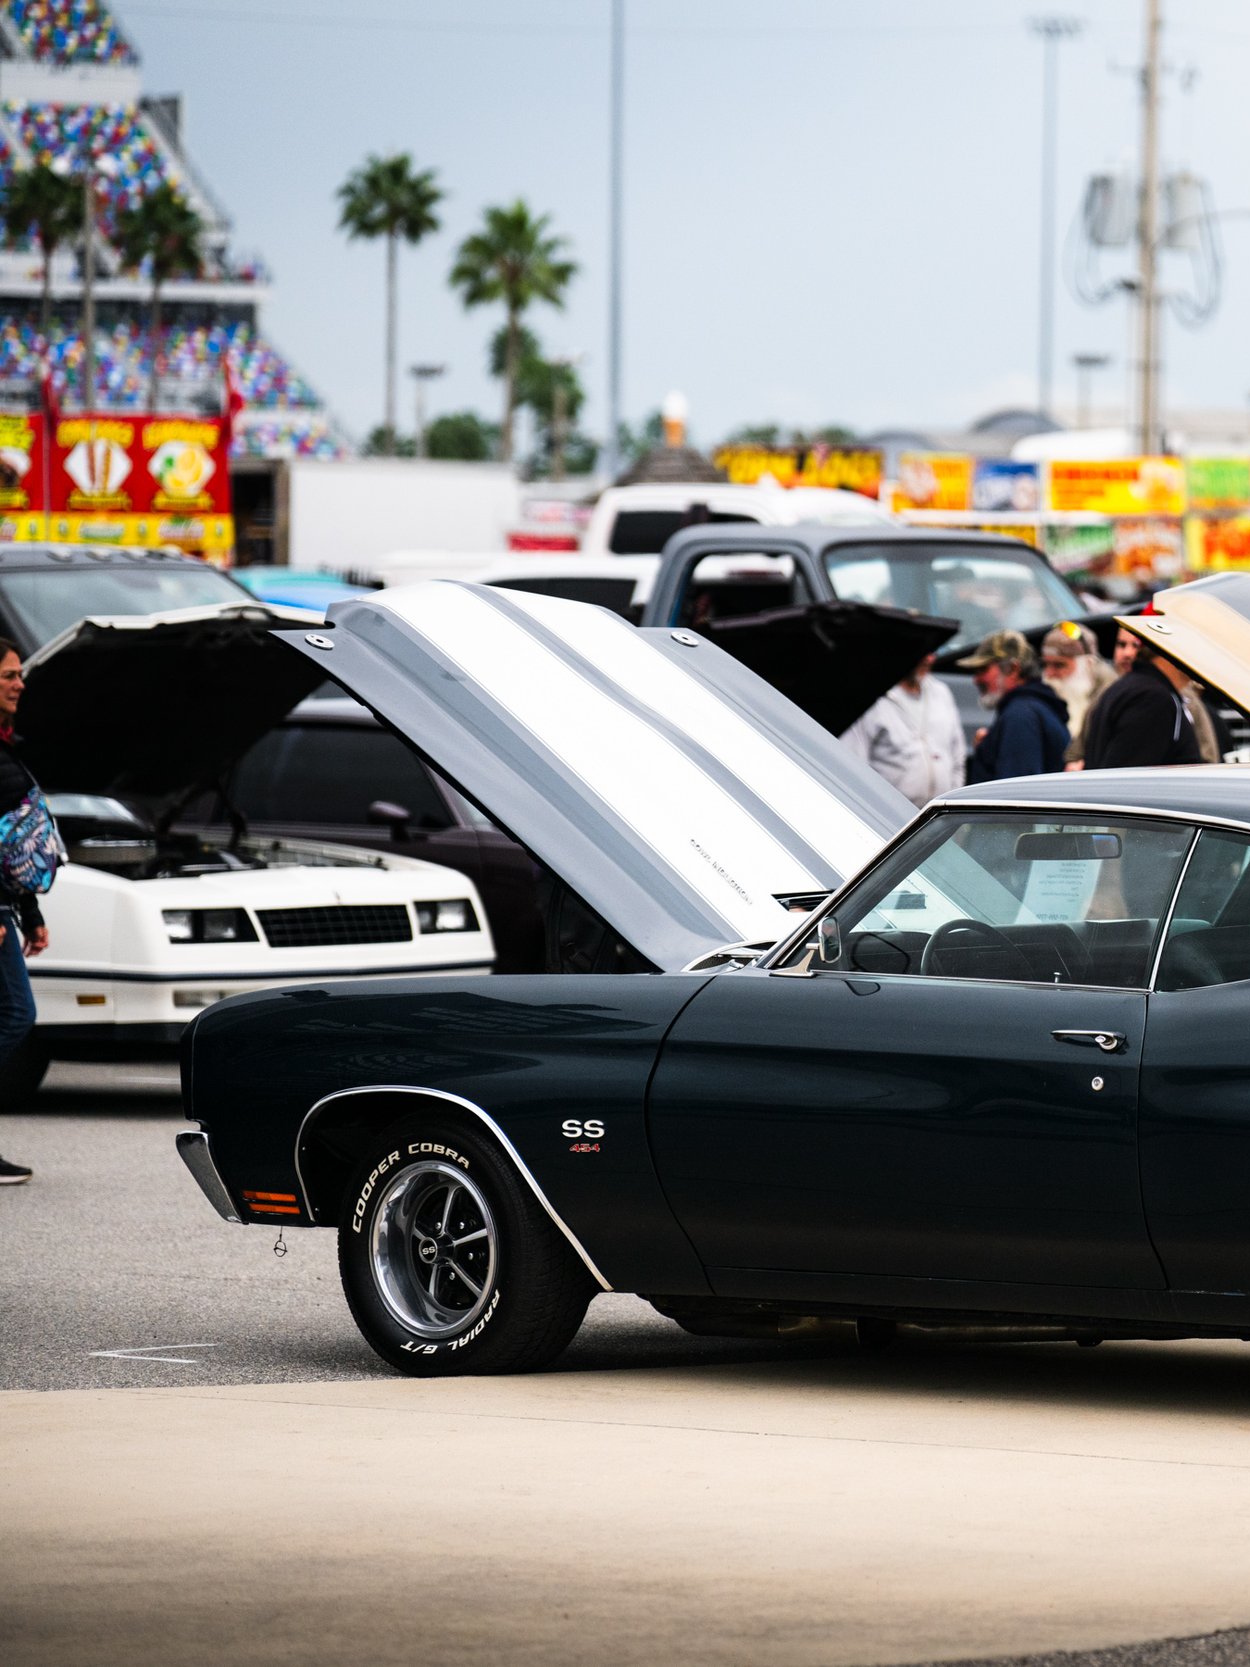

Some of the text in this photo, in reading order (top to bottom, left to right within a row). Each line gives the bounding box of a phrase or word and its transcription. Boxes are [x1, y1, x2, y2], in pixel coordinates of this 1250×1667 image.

[561, 1119, 605, 1138] SS
[569, 1143, 601, 1153] 454
[352, 1142, 470, 1234] COOPER COBRA
[422, 1246, 436, 1255] SS
[399, 1288, 501, 1355] RADIAL G/T
